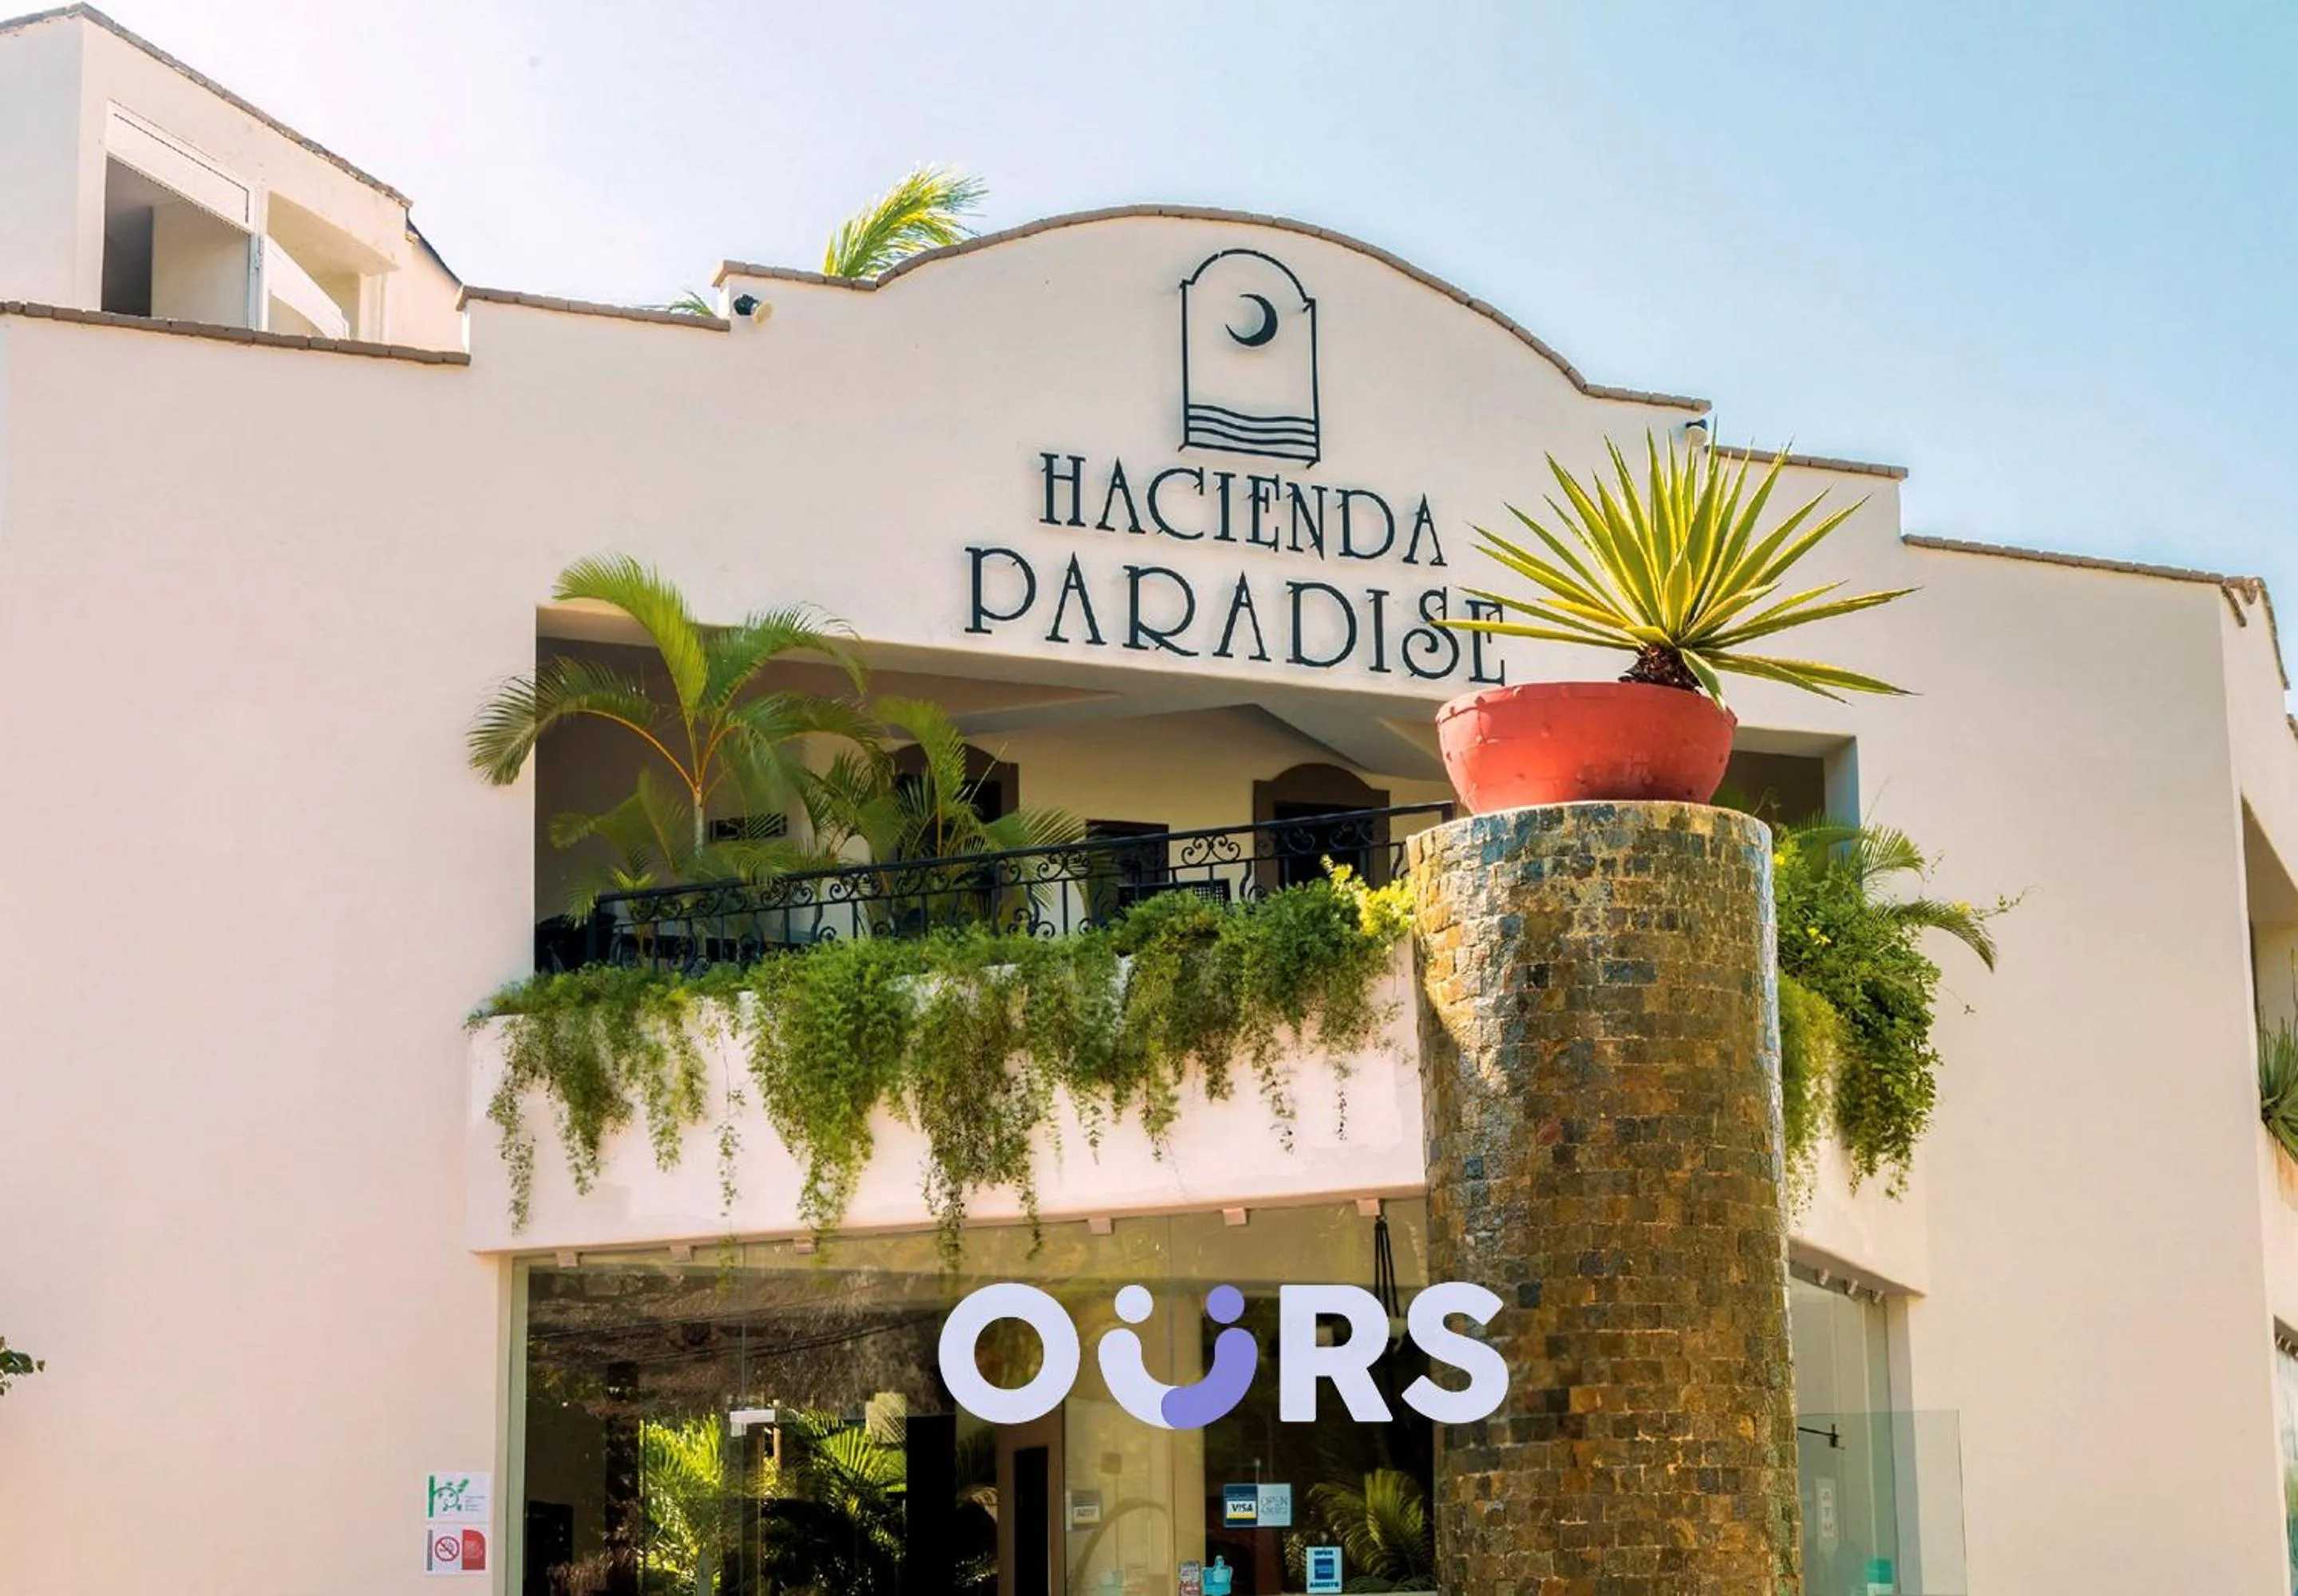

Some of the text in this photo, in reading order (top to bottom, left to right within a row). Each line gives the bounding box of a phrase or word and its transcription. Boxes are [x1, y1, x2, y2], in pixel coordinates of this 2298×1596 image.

[1039, 452, 1449, 567] HACIENDA
[964, 546, 1505, 686] PARADISE
[1232, 1503, 1253, 1512] VISA
